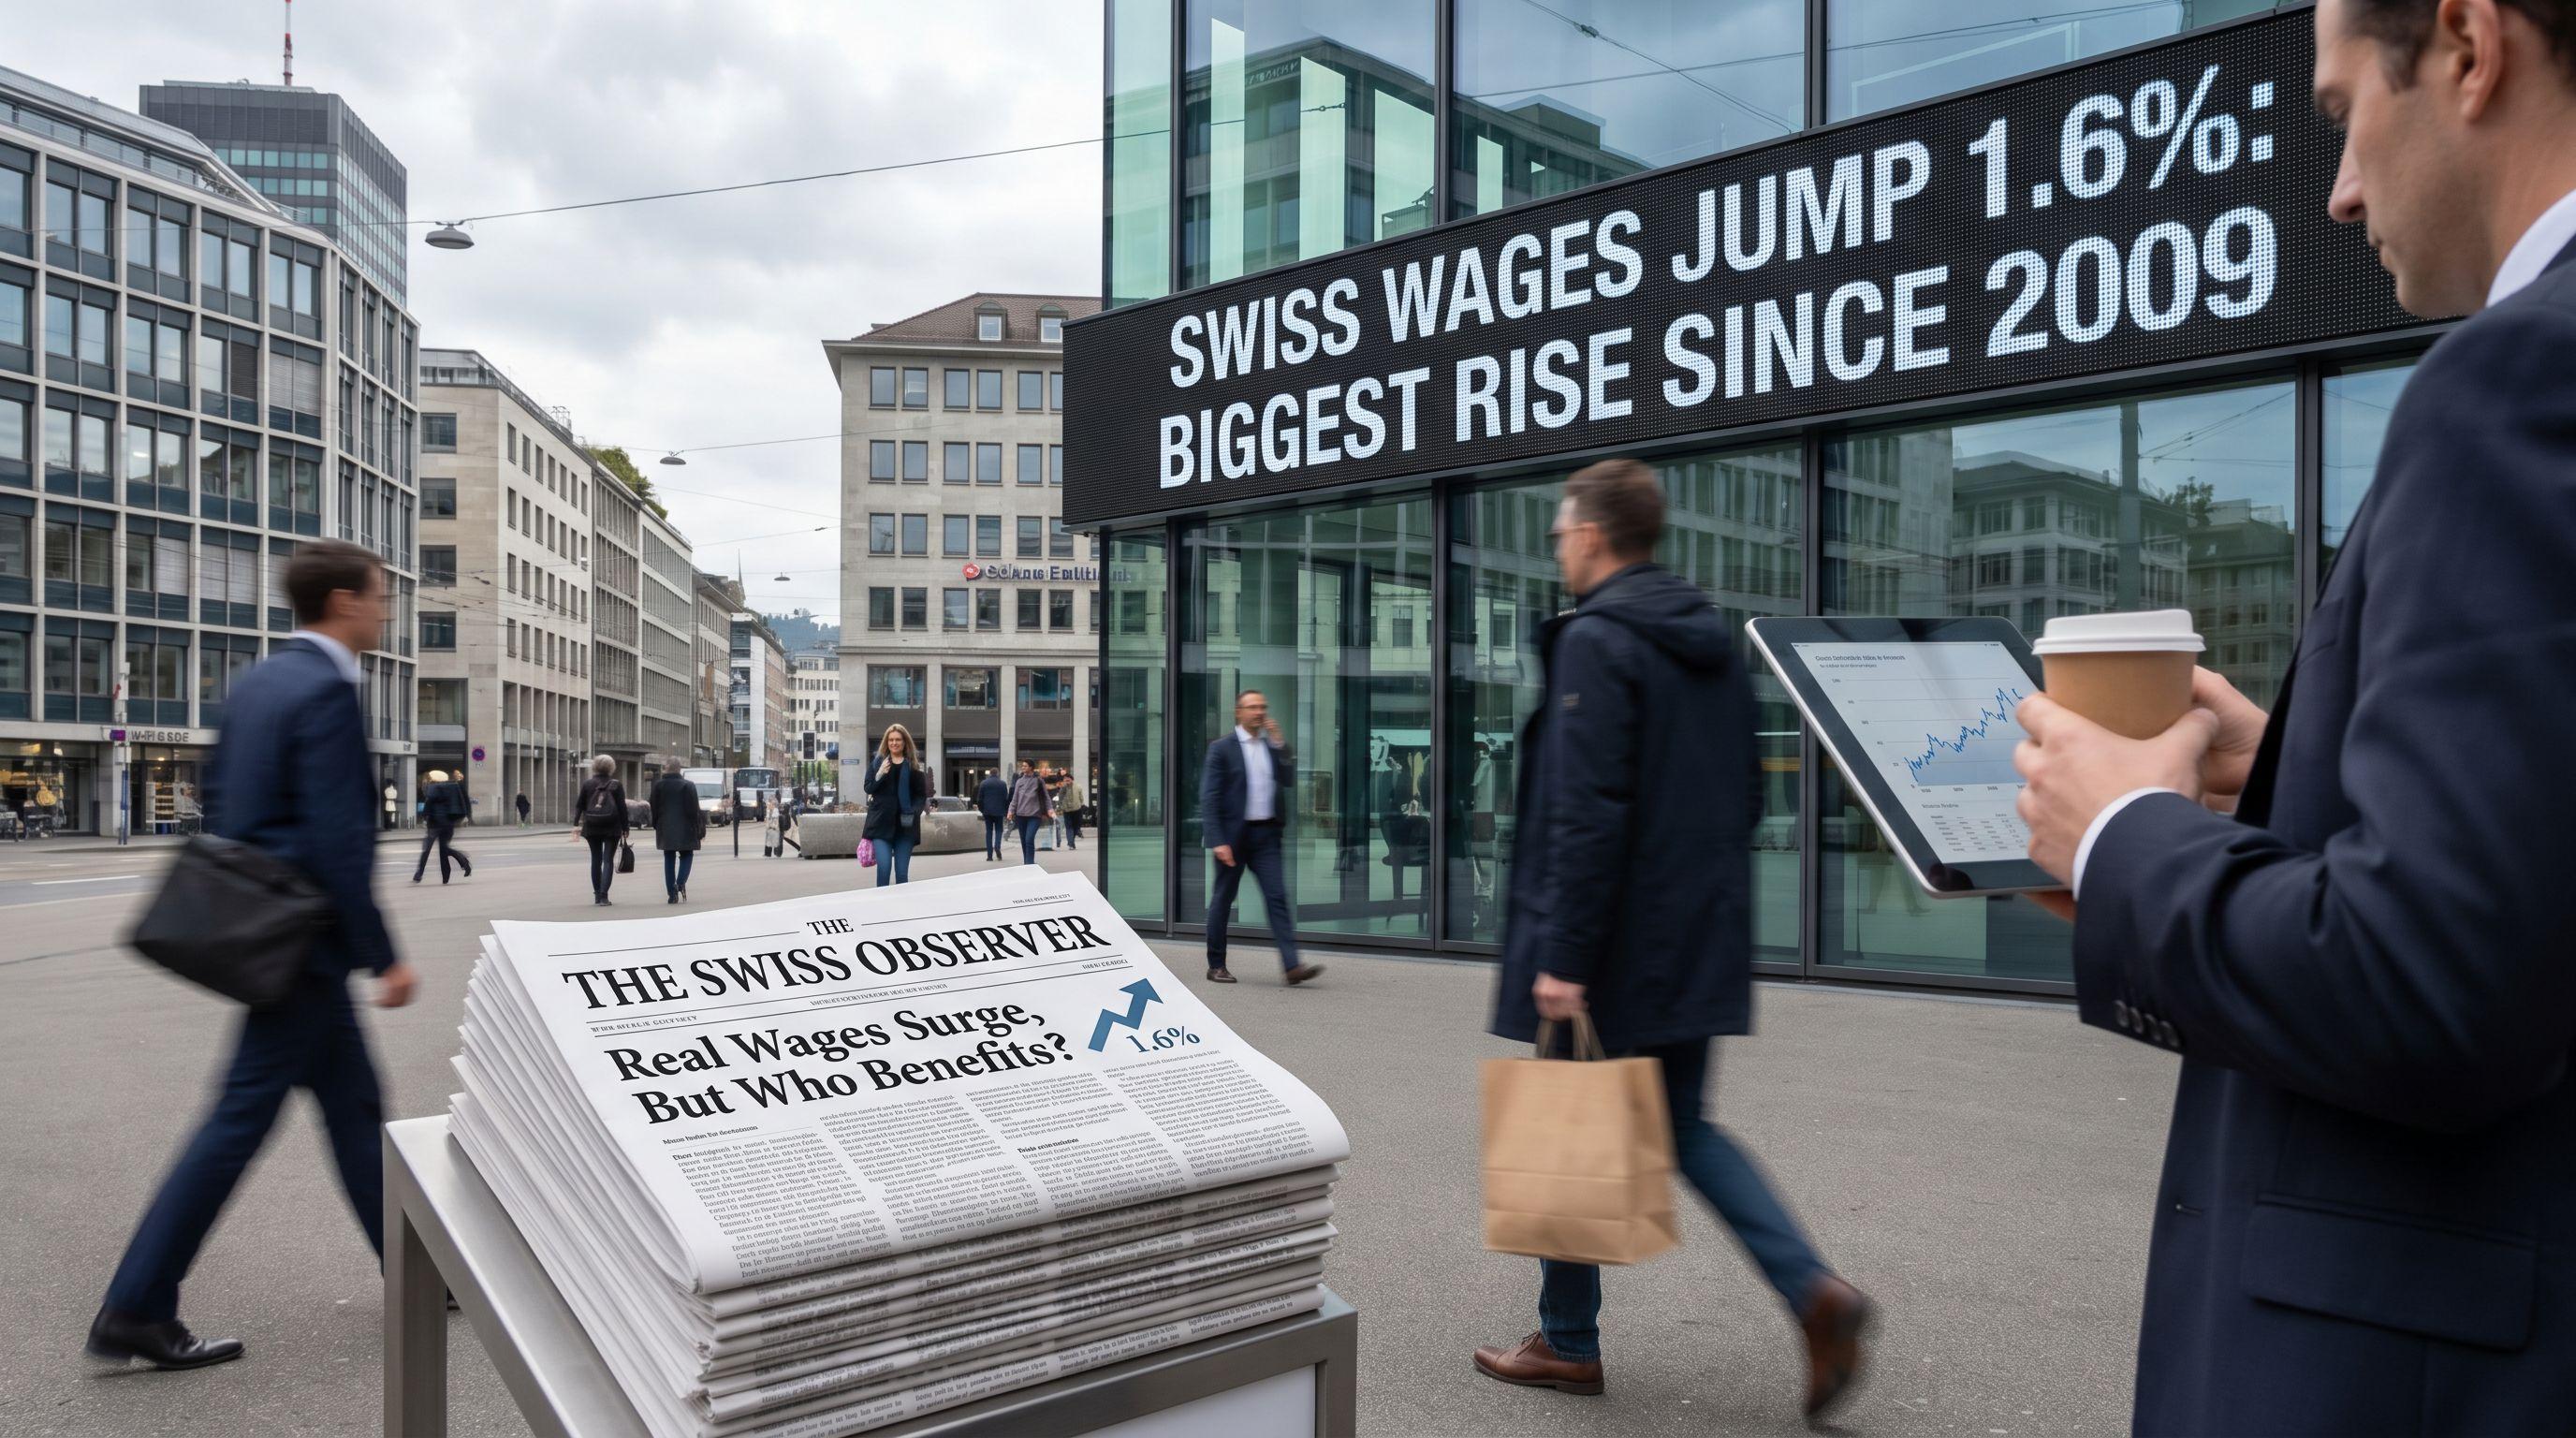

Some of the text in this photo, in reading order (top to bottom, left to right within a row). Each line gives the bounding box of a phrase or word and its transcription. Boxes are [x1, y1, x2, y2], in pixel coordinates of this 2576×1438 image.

[1169, 64, 2275, 389] SWISS WAGES JUMP 1.6%:
[1159, 205, 2276, 489] BIGGEST RISE SINCE 2009
[562, 963, 689, 1009] THE
[690, 946, 852, 996] SWISS
[855, 915, 1112, 976] OBSERVER
[806, 917, 854, 936] THE
[603, 1034, 731, 1081] Real
[724, 1023, 891, 1064] Wages
[893, 1000, 1046, 1041] Surge,
[631, 1032, 1075, 1124] But Who Benefits?
[1124, 1024, 1202, 1054] 1.6%
